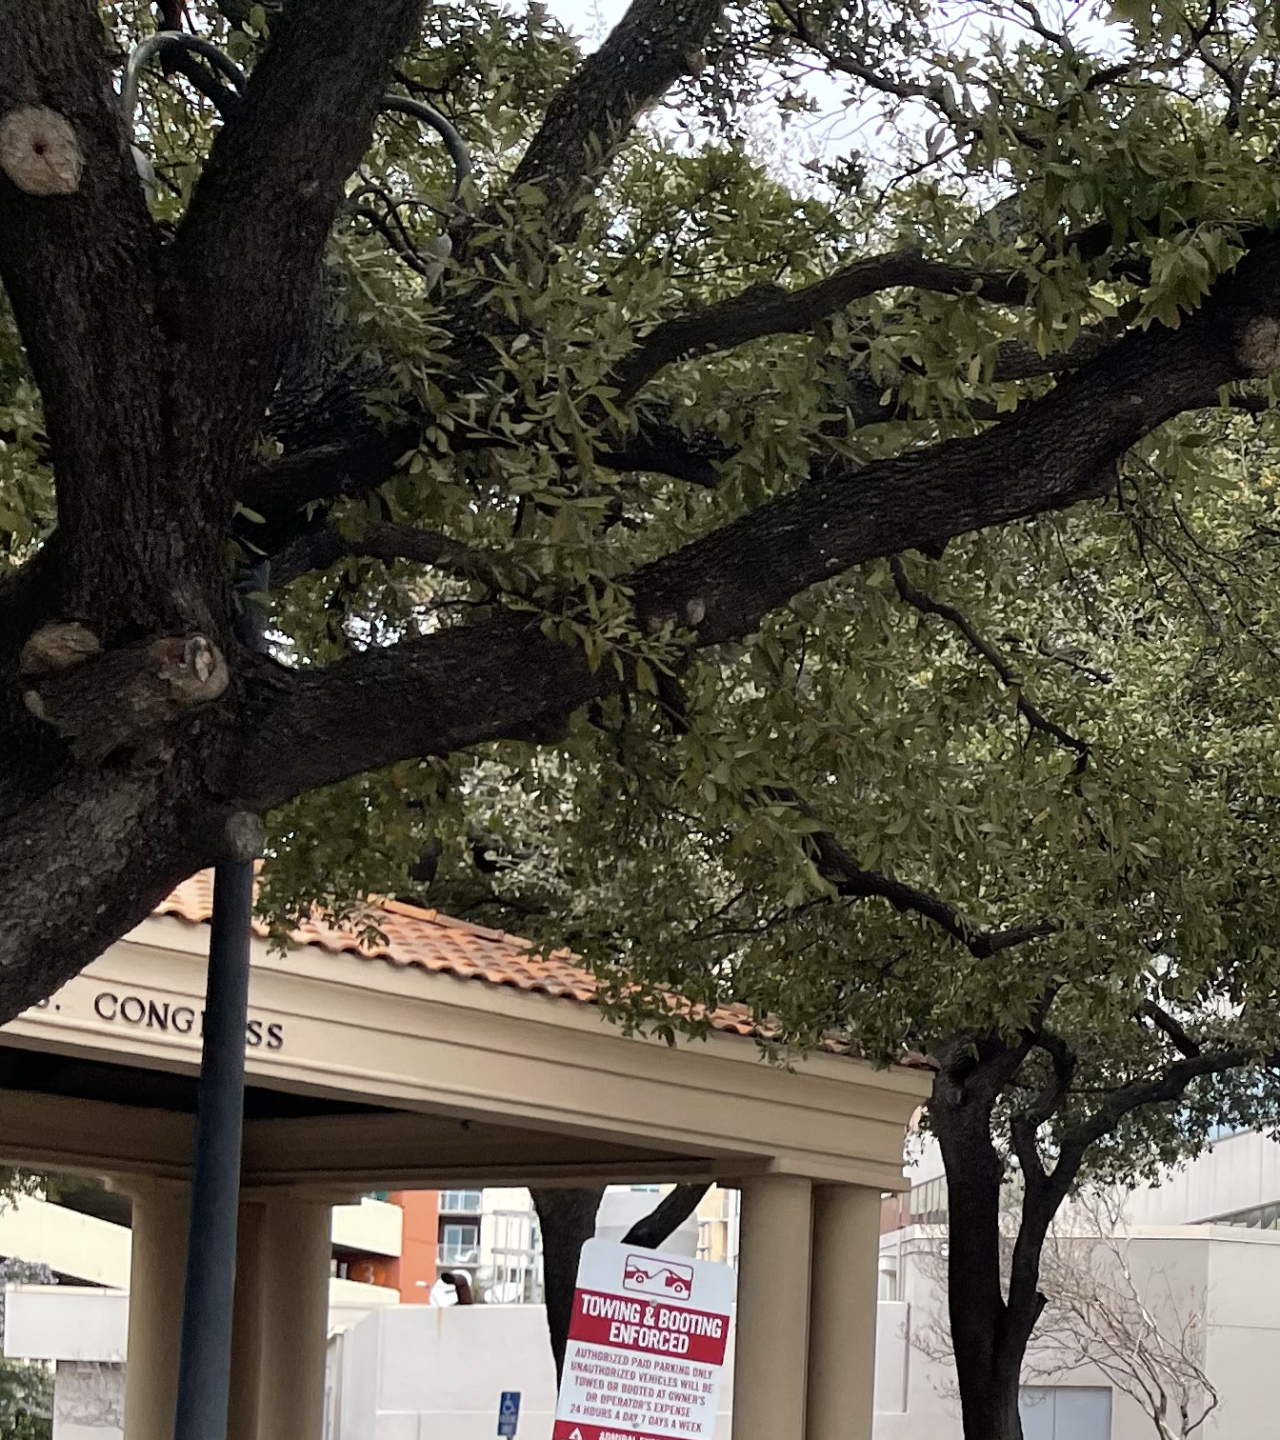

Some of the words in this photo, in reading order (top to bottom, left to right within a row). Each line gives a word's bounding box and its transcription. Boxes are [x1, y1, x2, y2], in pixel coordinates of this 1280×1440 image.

[94, 992, 284, 1049] CONGSS
[581, 1293, 641, 1323] TOWING
[643, 1306, 655, 1326] &
[658, 1309, 723, 1338] BOOTING
[609, 1322, 689, 1354] ENFORCED
[570, 1361, 636, 1380] UNAUTHORIZED
[638, 1371, 678, 1388] VEHICLES
[680, 1379, 699, 1391] WILL
[702, 1383, 714, 1393] BE
[575, 1347, 629, 1366] AUTHORIZED
[631, 1357, 652, 1369] PAID
[653, 1361, 690, 1376] PARKING
[692, 1367, 713, 1380] ONLY
[575, 1375, 605, 1390] TOWED
[607, 1381, 619, 1392] OR
[621, 1383, 654, 1397] BOOTED
[656, 1389, 666, 1399] AT
[668, 1391, 706, 1406] OWNER'S
[585, 1392, 598, 1403] OR
[600, 1393, 652, 1411] OPERATOR'S
[653, 1402, 691, 1417] EXPENSE
[570, 1403, 581, 1413] 24
[583, 1405, 612, 1419] HOURS
[614, 1411, 620, 1420] A
[622, 1411, 638, 1422] DAY
[640, 1414, 646, 1424] 7
[648, 1416, 669, 1428] DAYS
[671, 1419, 676, 1429] A
[679, 1420, 702, 1433] WEEK
